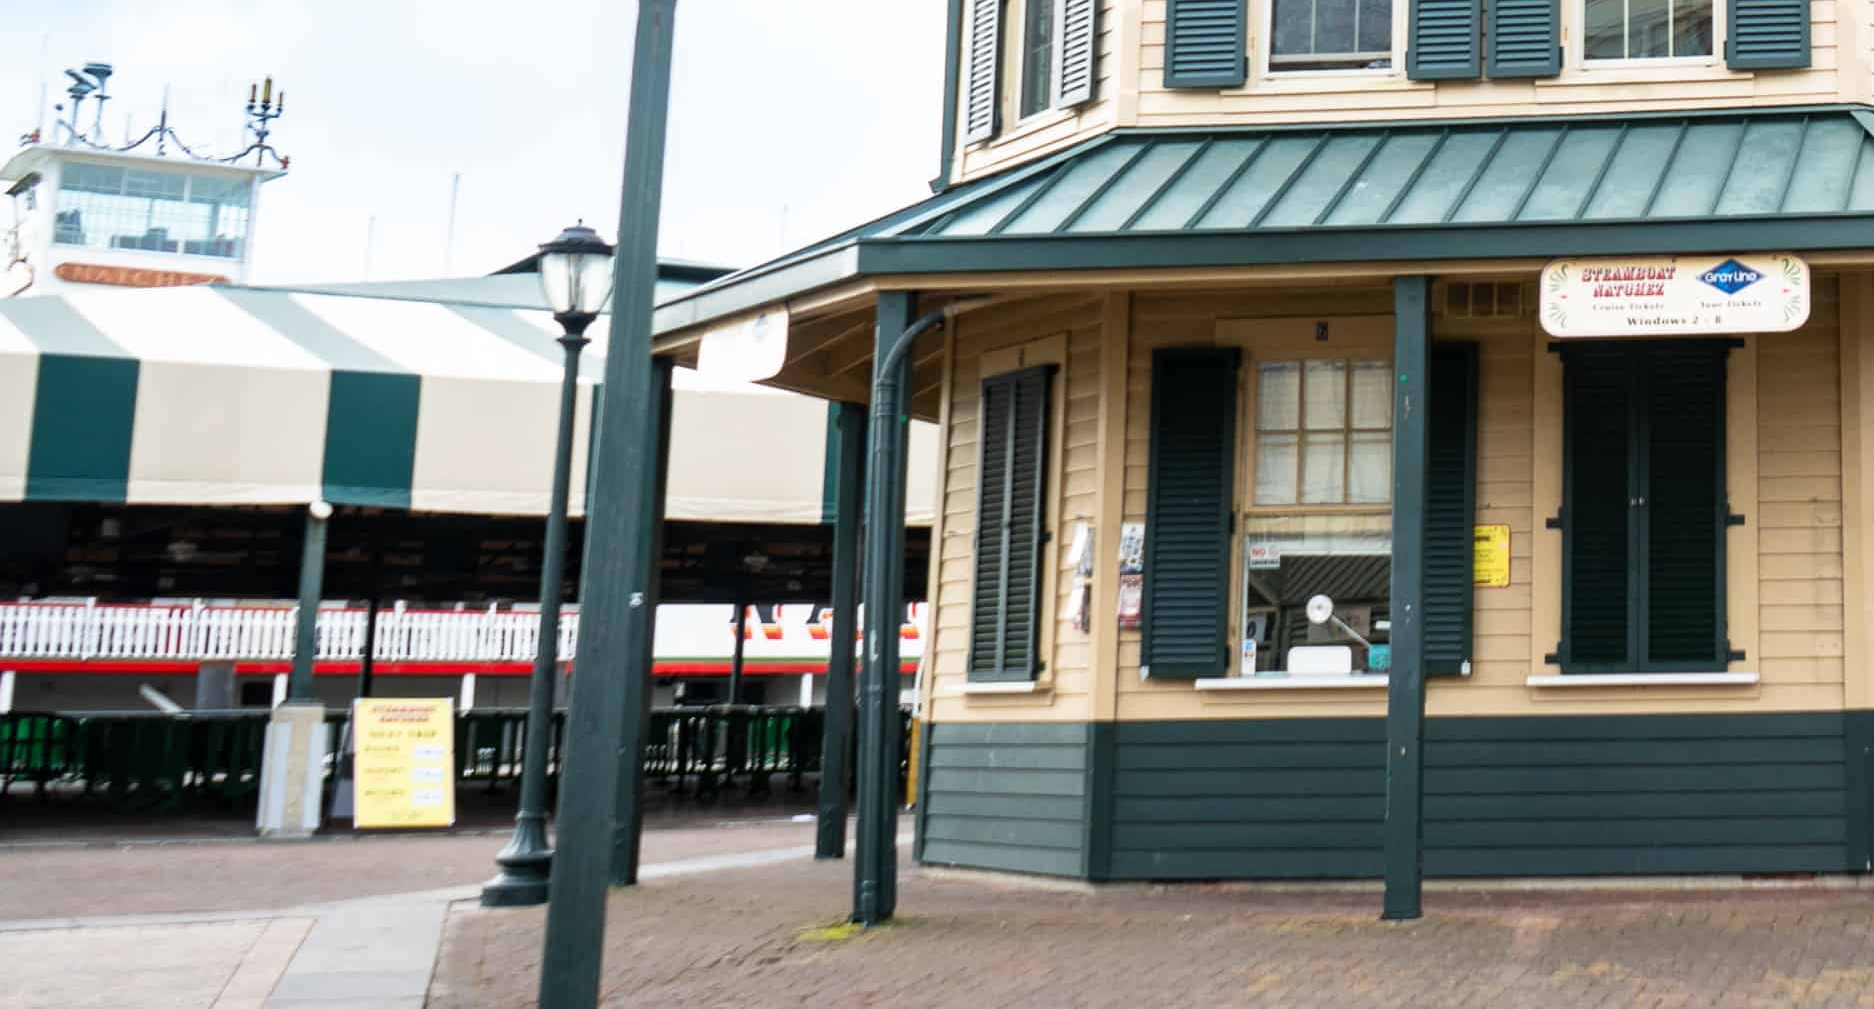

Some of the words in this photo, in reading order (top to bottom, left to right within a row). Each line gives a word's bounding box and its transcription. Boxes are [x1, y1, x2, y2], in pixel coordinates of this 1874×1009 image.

[71, 266, 217, 288] NATCHE
[1582, 266, 1676, 282] STEAMBOAT
[1593, 283, 1665, 297] NATCHEZ
[1627, 316, 1687, 326] Windows
